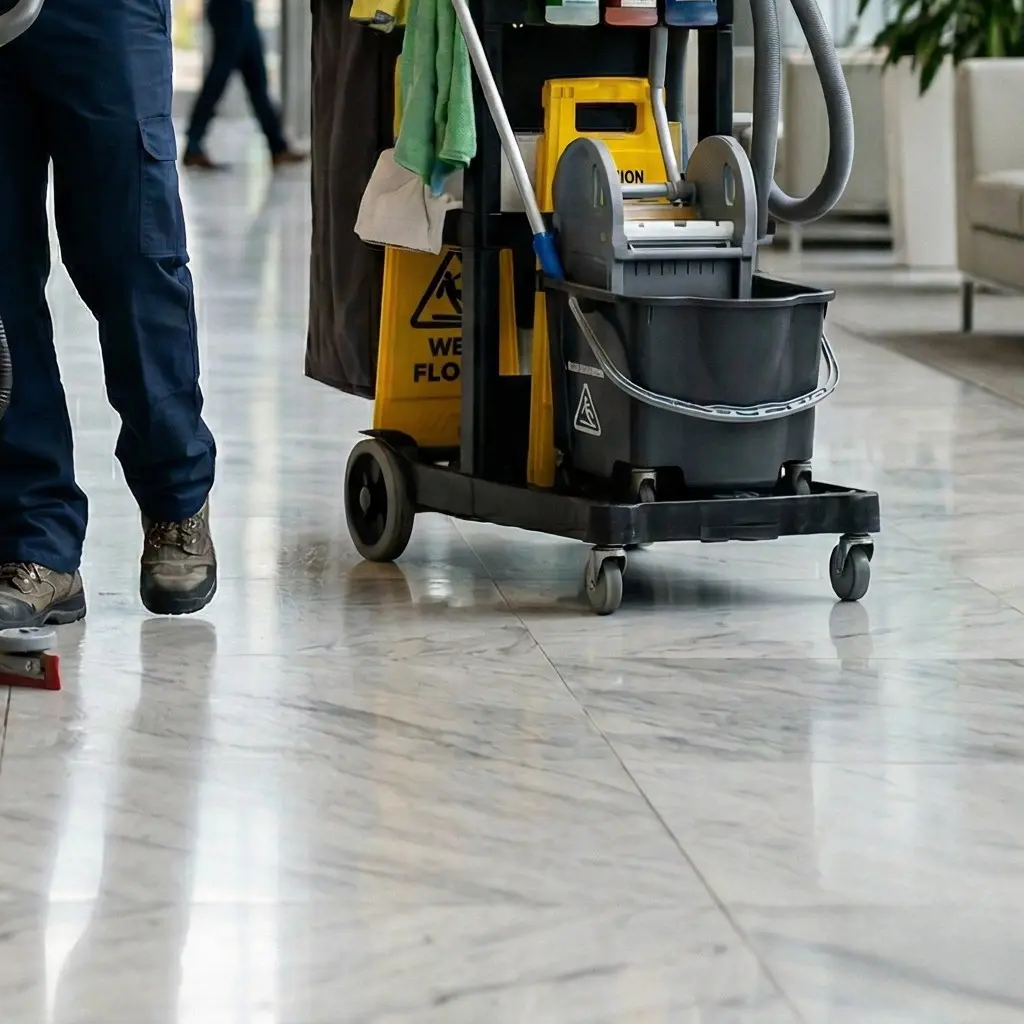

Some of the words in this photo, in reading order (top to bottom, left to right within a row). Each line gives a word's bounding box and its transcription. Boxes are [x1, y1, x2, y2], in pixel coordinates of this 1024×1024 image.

[617, 170, 644, 184] ION
[428, 337, 462, 356] WE
[414, 362, 460, 382] FLO
